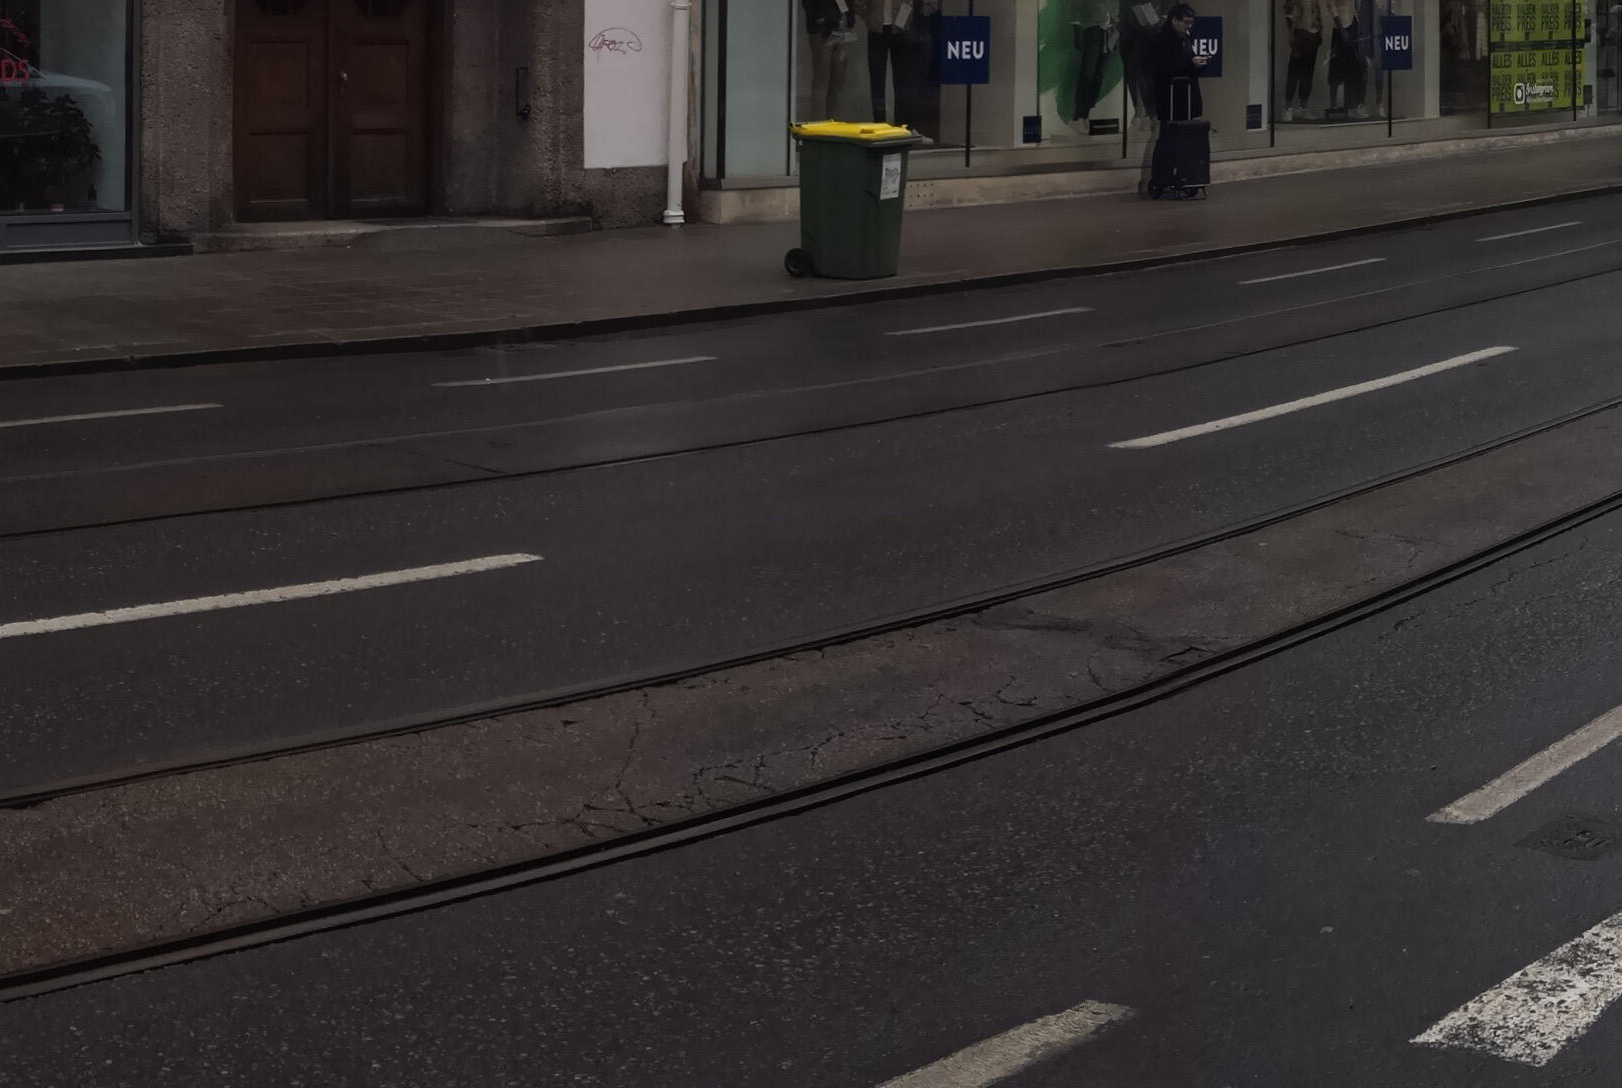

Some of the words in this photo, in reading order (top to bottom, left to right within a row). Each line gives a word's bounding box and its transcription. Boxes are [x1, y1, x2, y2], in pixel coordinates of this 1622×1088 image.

[946, 40, 985, 60] NEU
[1191, 38, 1219, 56] NEU
[1384, 35, 1409, 51] NEU
